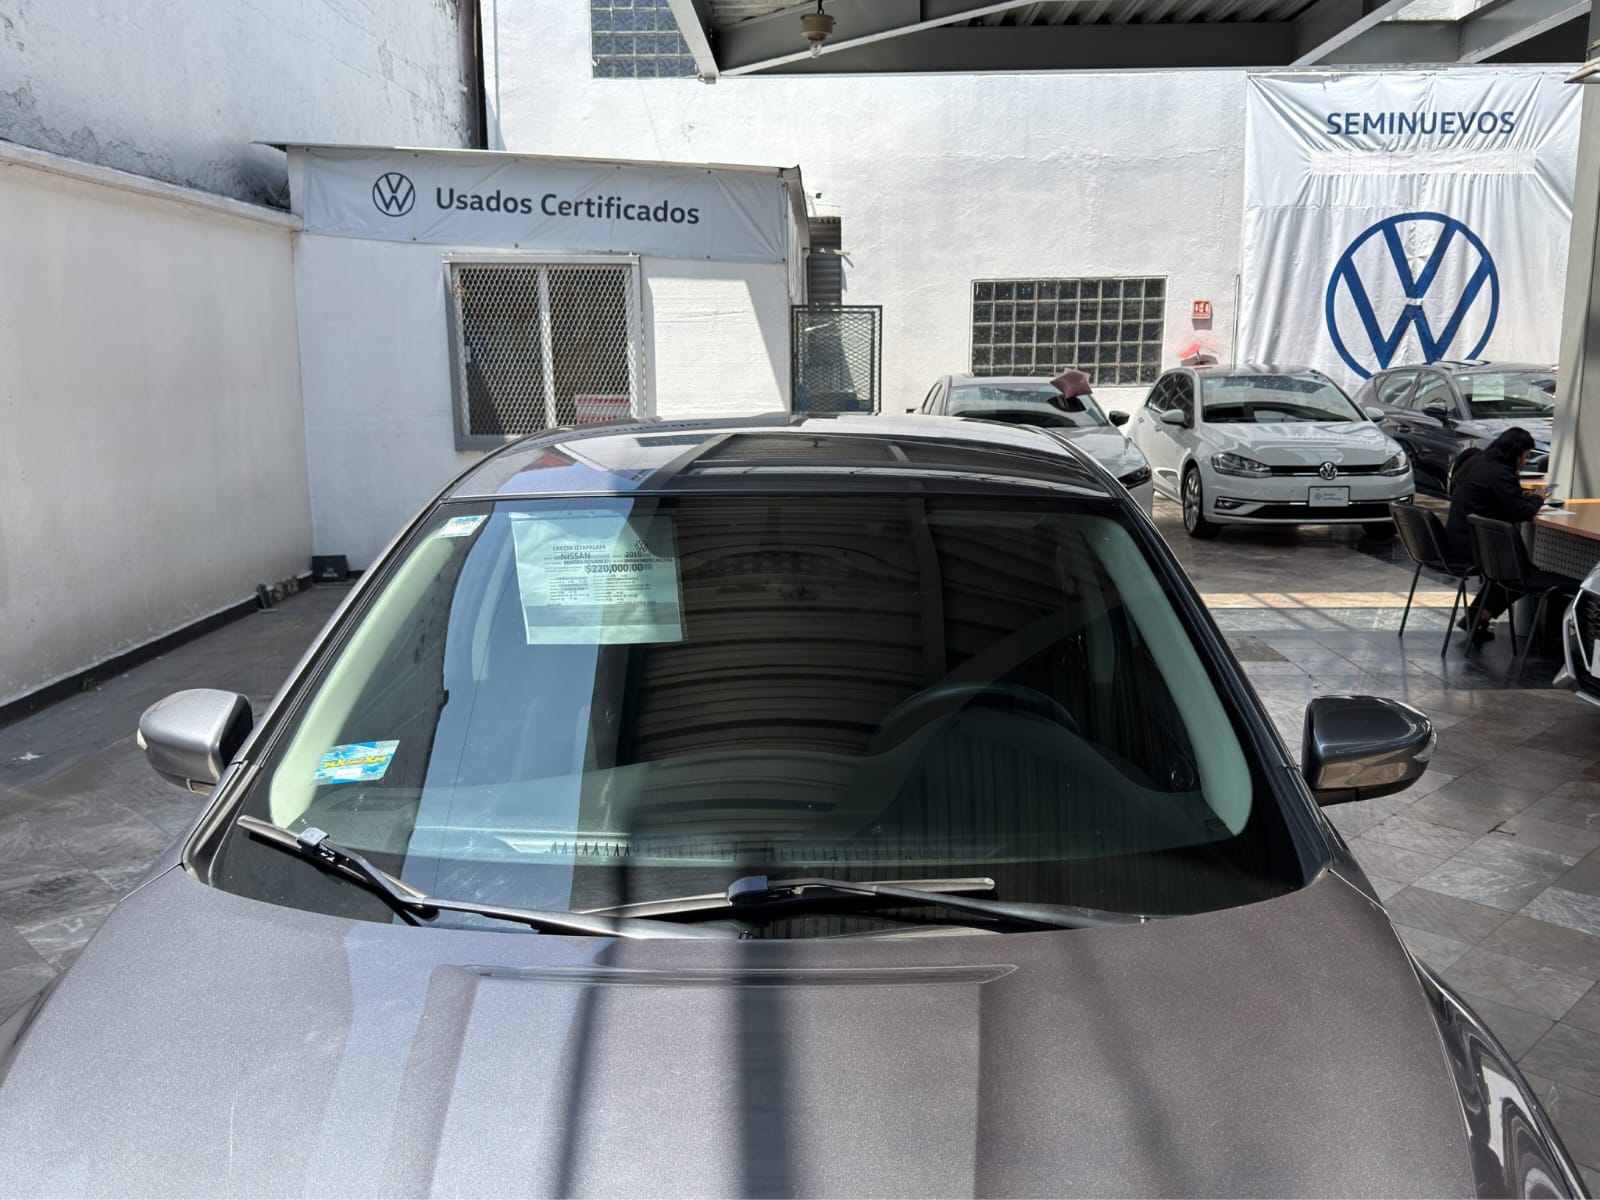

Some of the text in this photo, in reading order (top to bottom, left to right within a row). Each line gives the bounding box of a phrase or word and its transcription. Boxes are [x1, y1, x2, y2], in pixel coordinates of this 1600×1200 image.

[1326, 111, 1515, 135] SEMINUEVOS
[372, 172, 700, 225] VW Usados Certificados
[1326, 212, 1499, 377] VW
[560, 552, 591, 560] NISSAN
[585, 564, 644, 574] $220,000.00
